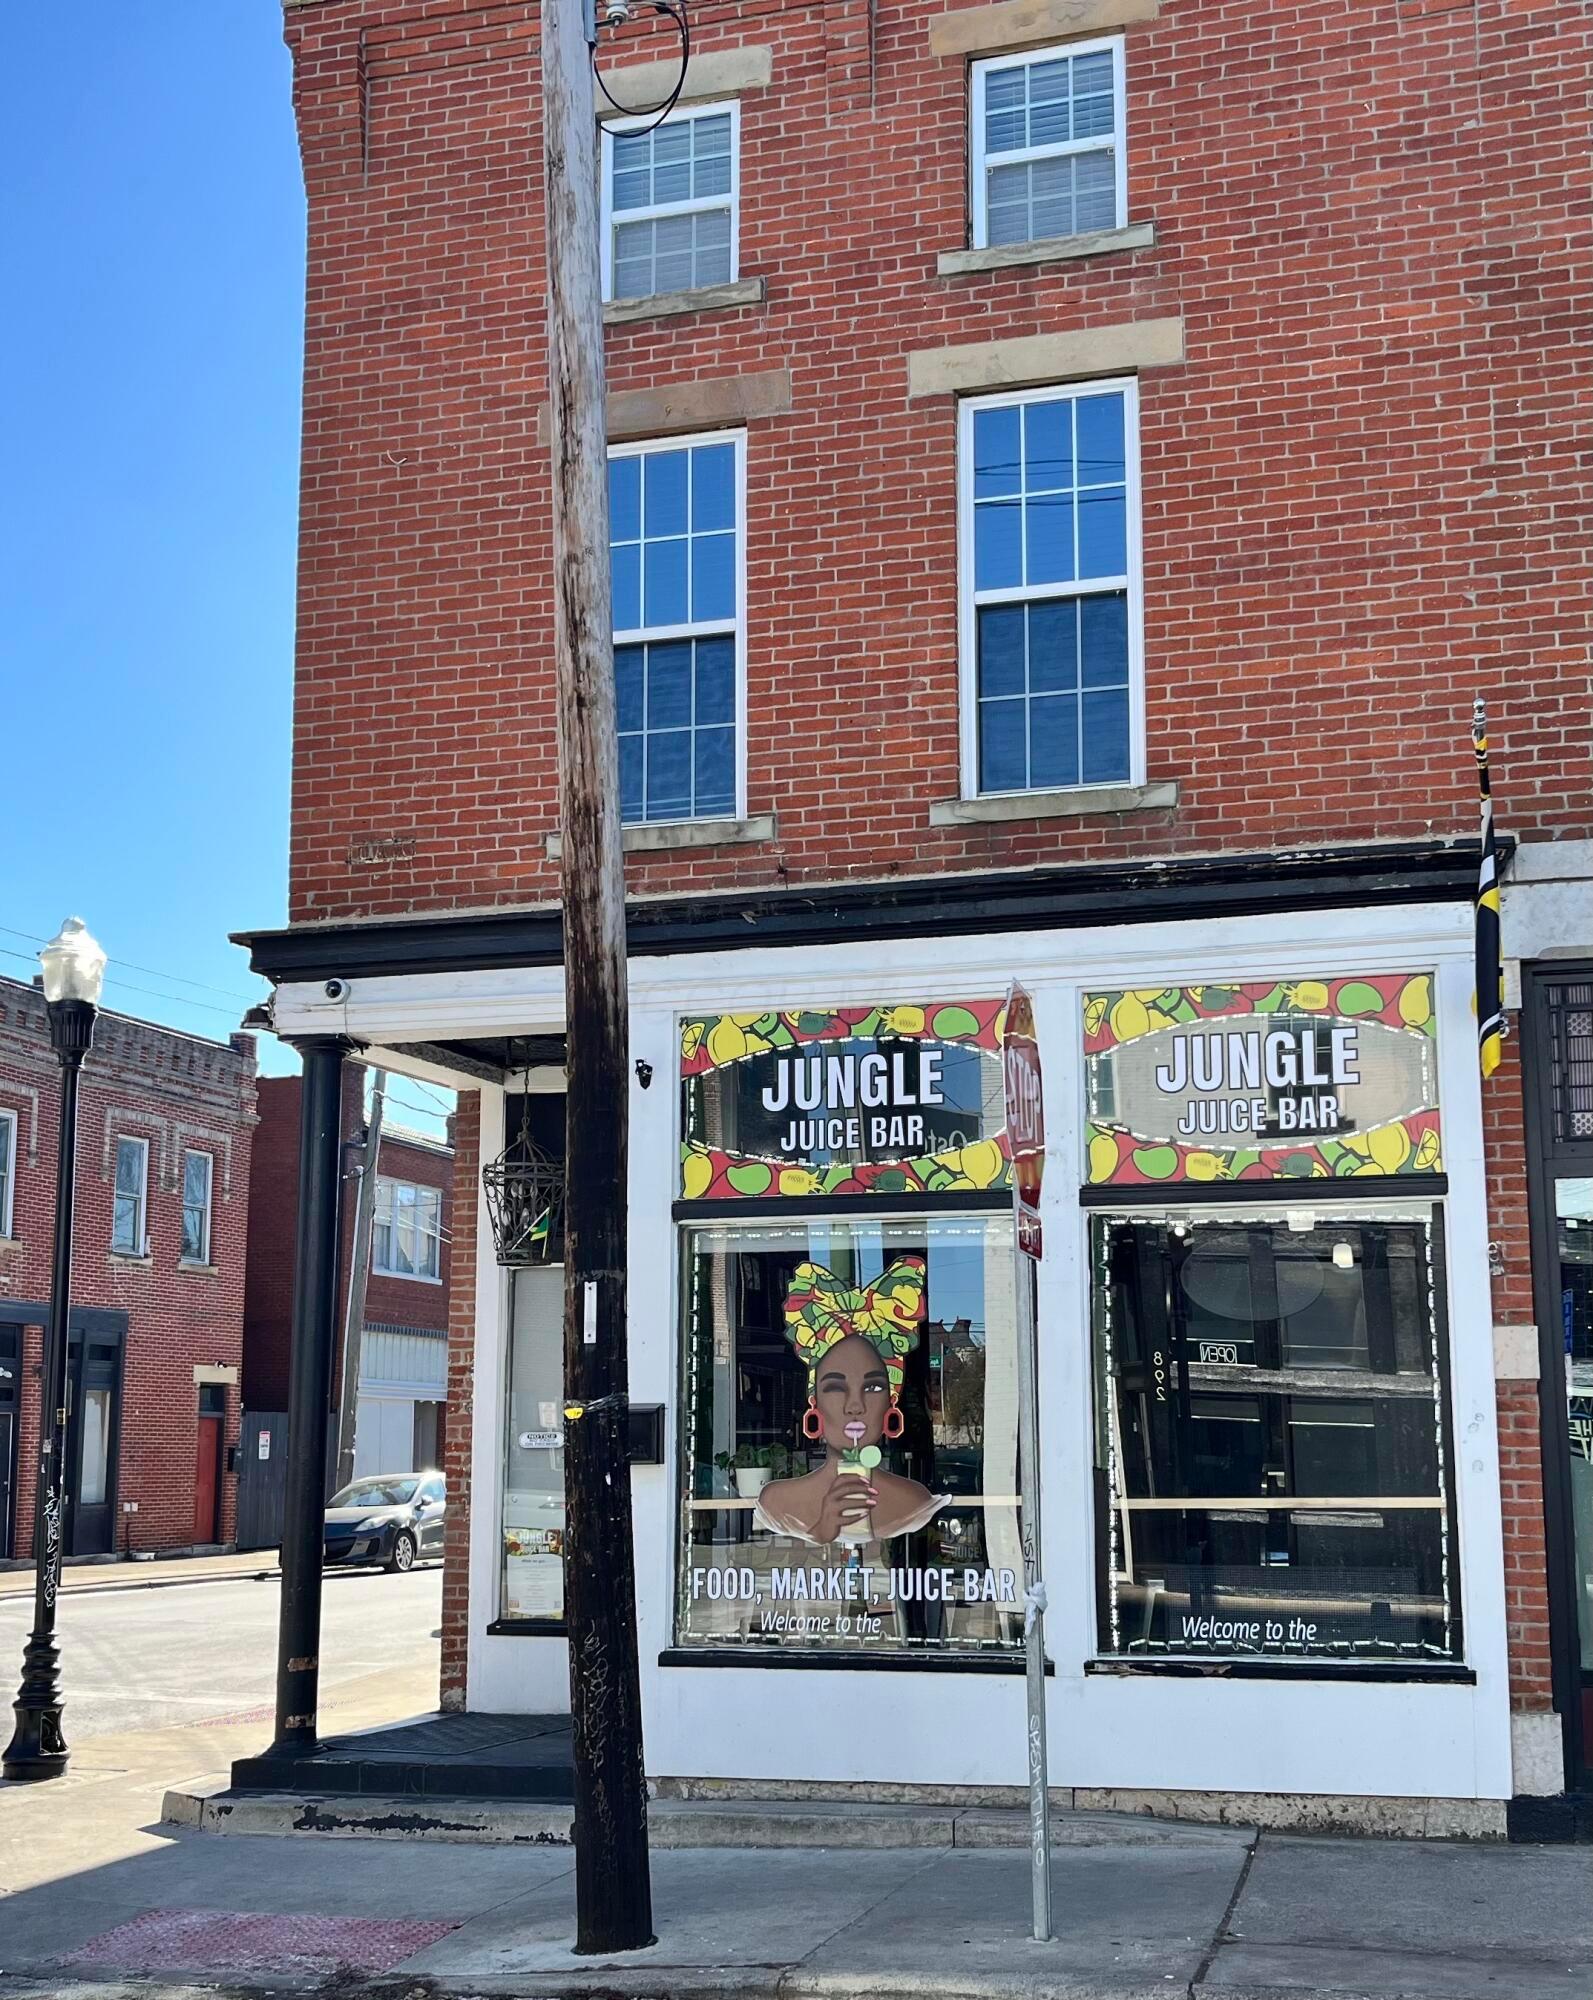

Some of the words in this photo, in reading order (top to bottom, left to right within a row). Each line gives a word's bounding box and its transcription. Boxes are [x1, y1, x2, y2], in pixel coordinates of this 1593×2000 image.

[1156, 1026, 1361, 1093] JUNGLE
[762, 1050, 944, 1112] JUNGLE
[1005, 1045, 1041, 1143] STOP
[780, 1117, 859, 1151] JUICE
[871, 1114, 925, 1147] BAR
[1178, 1098, 1266, 1135] JUICE
[1279, 1095, 1339, 1130] BAR
[693, 1567, 763, 1605] FOOD,
[770, 1567, 879, 1605] MARKET,
[887, 1567, 955, 1601] JUICE
[963, 1567, 1016, 1601] BAR
[760, 1610, 830, 1634] Welcome
[835, 1612, 851, 1633] to
[856, 1611, 881, 1634] the
[1182, 1615, 1260, 1639] Welcome
[1265, 1619, 1283, 1640] to
[1289, 1617, 1317, 1640] the
